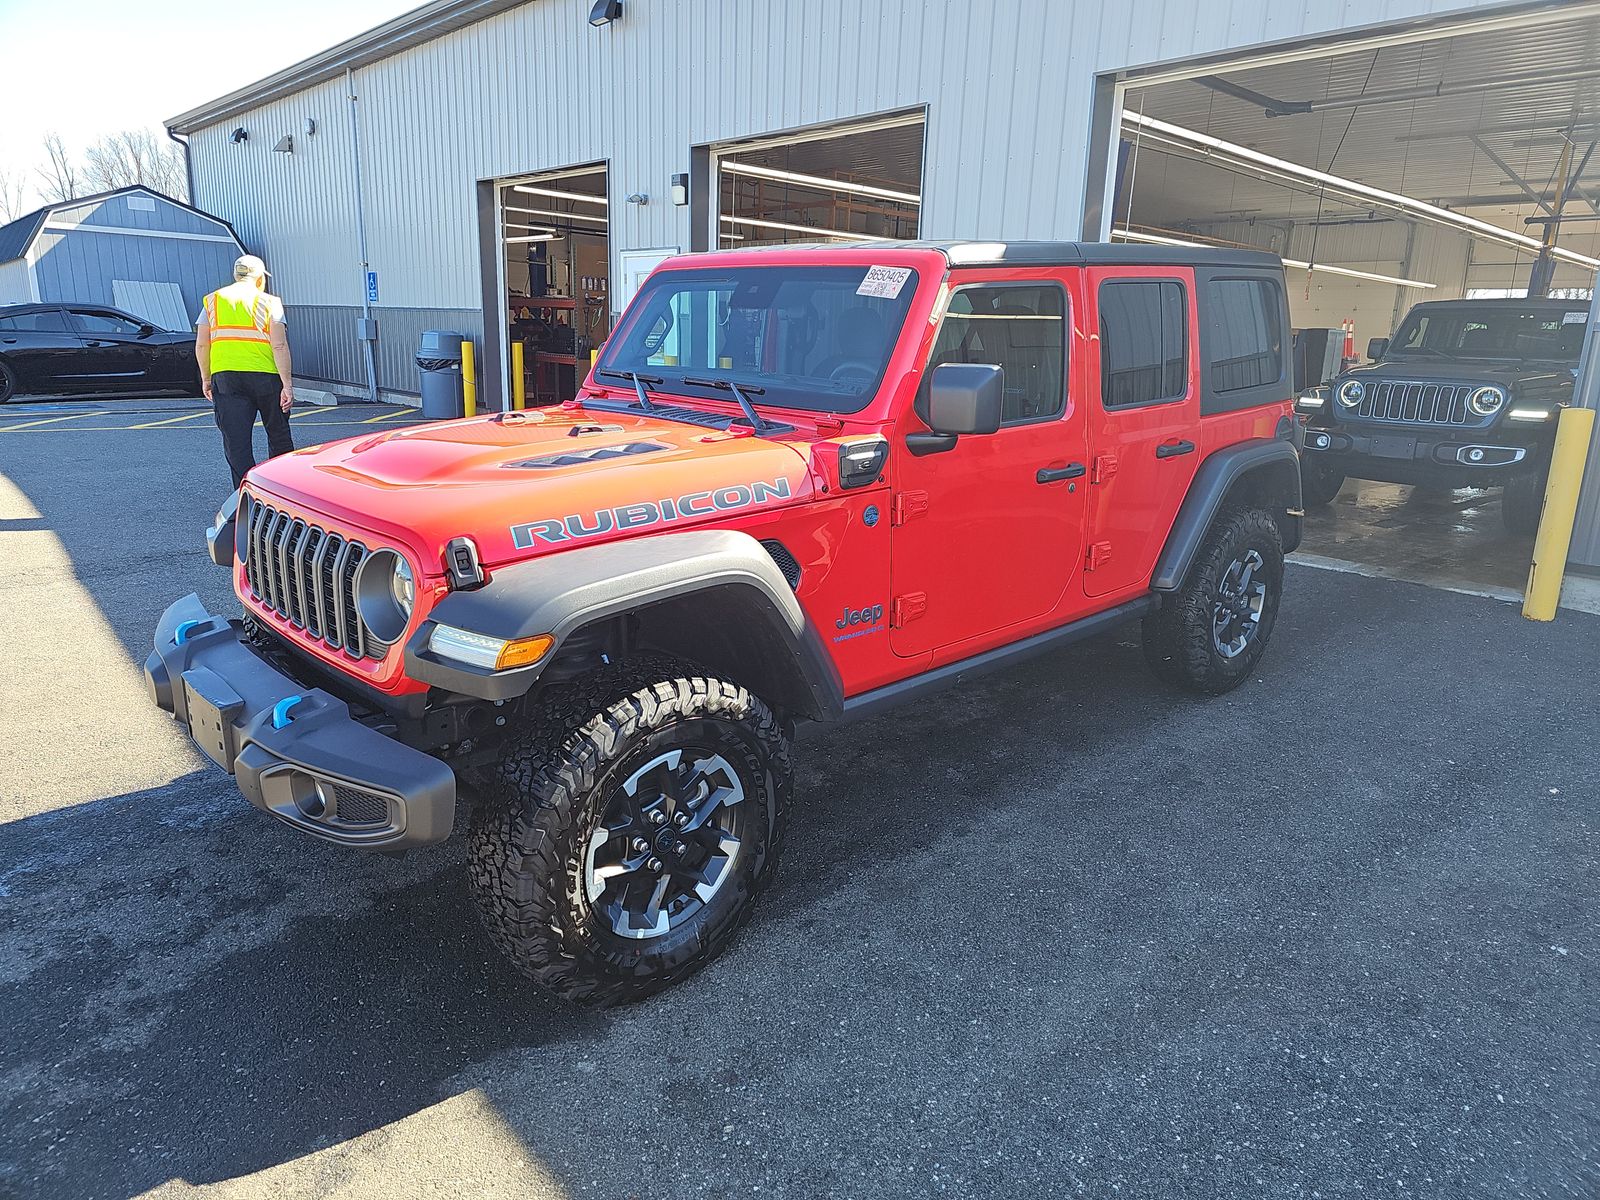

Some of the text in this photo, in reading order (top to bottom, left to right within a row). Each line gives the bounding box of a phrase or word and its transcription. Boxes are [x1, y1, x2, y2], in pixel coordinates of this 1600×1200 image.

[867, 268, 906, 284] 8650405
[510, 477, 791, 549] RUBICON
[836, 604, 883, 629] Jeep
